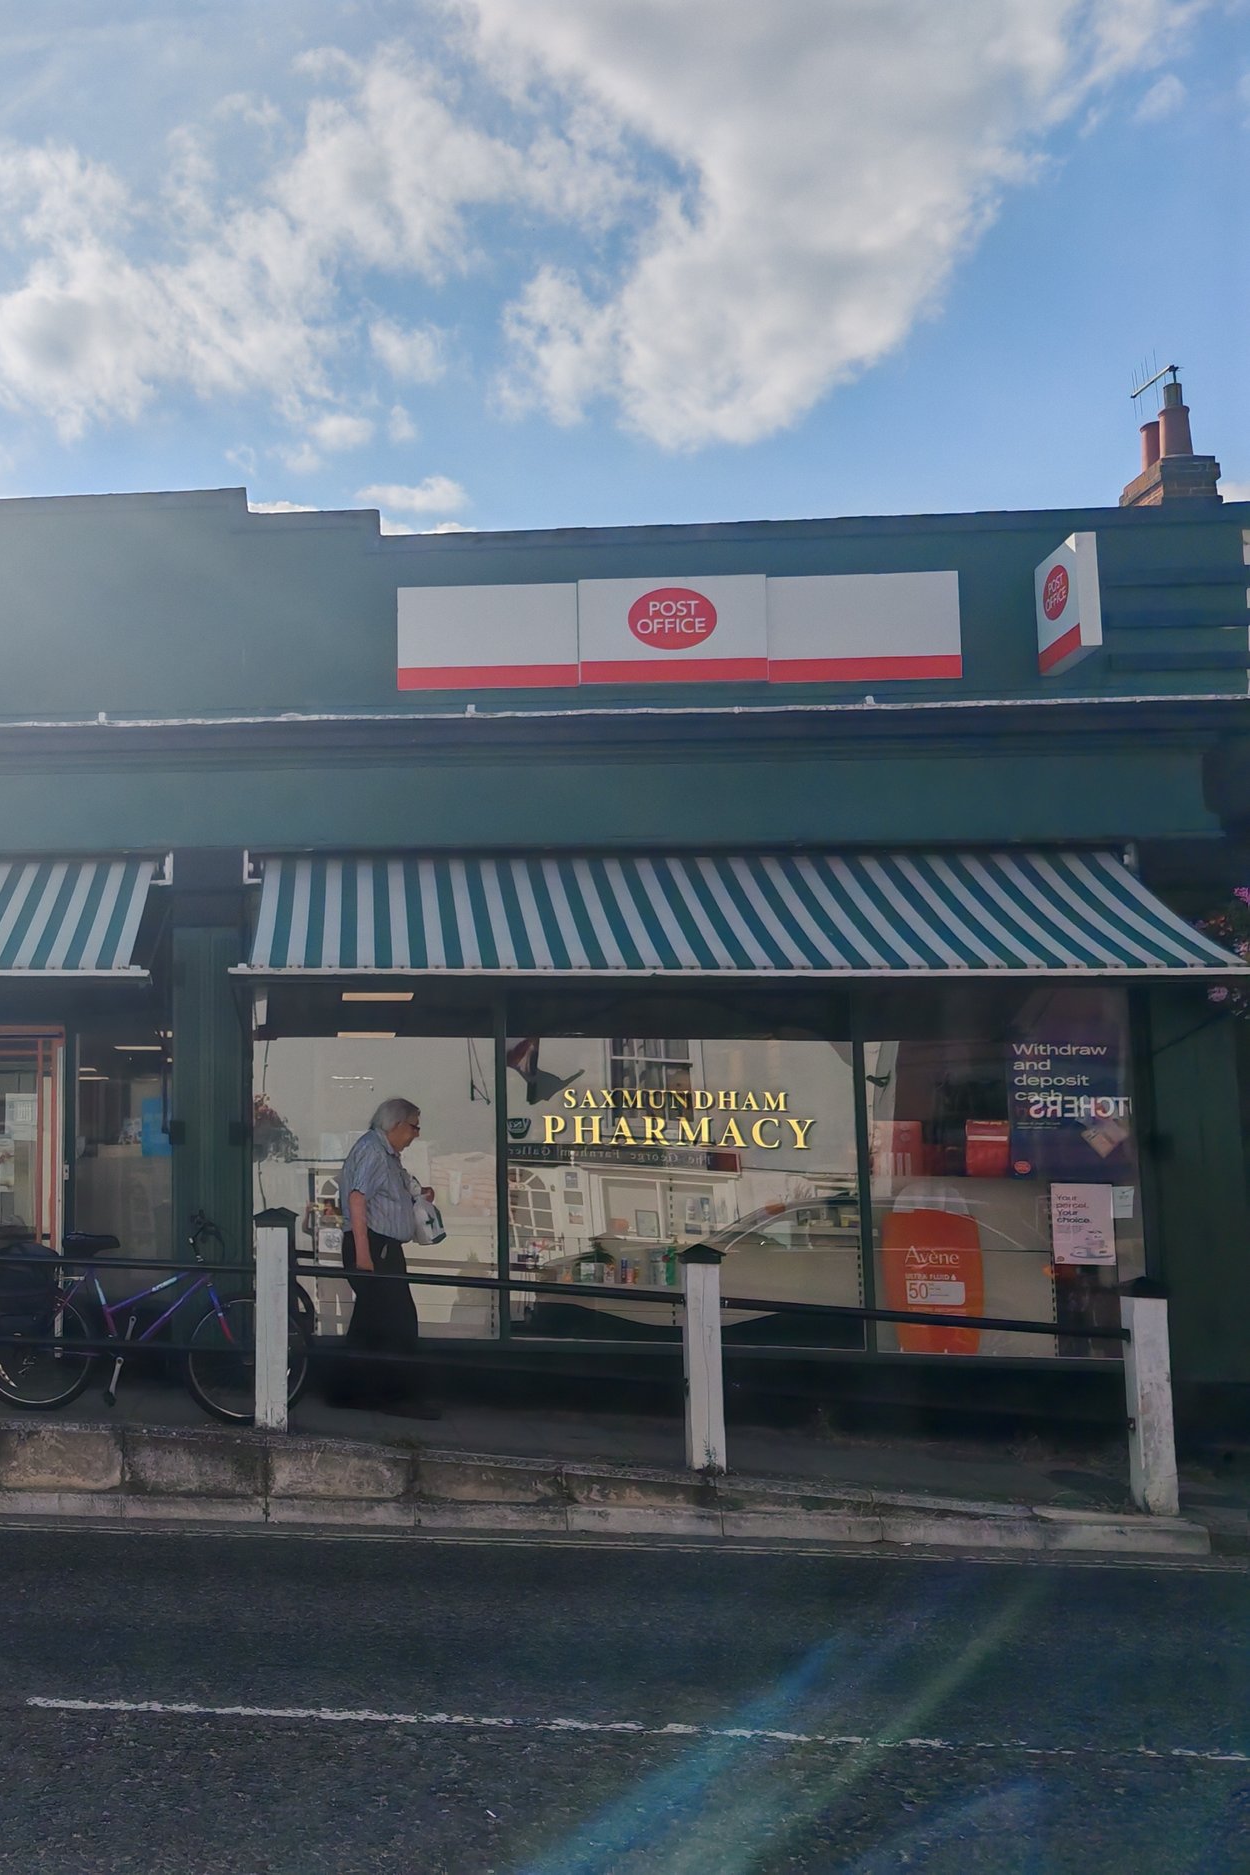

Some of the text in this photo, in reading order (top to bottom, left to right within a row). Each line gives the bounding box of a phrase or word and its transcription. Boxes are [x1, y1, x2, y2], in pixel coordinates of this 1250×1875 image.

[1047, 572, 1063, 597] POST
[1045, 585, 1066, 612] OFFICE
[649, 600, 699, 616] POST
[637, 618, 707, 634] OFFICE
[1012, 1043, 1107, 1056] Withdraw
[1013, 1059, 1051, 1071] and
[1014, 1074, 1090, 1088] deposit
[563, 1088, 788, 1112] SAXMUNDHAM
[1015, 1090, 1063, 1102] cash
[542, 1115, 816, 1149] PHARMACY
[904, 1245, 960, 1265] Avène
[908, 1282, 929, 1299] 50
